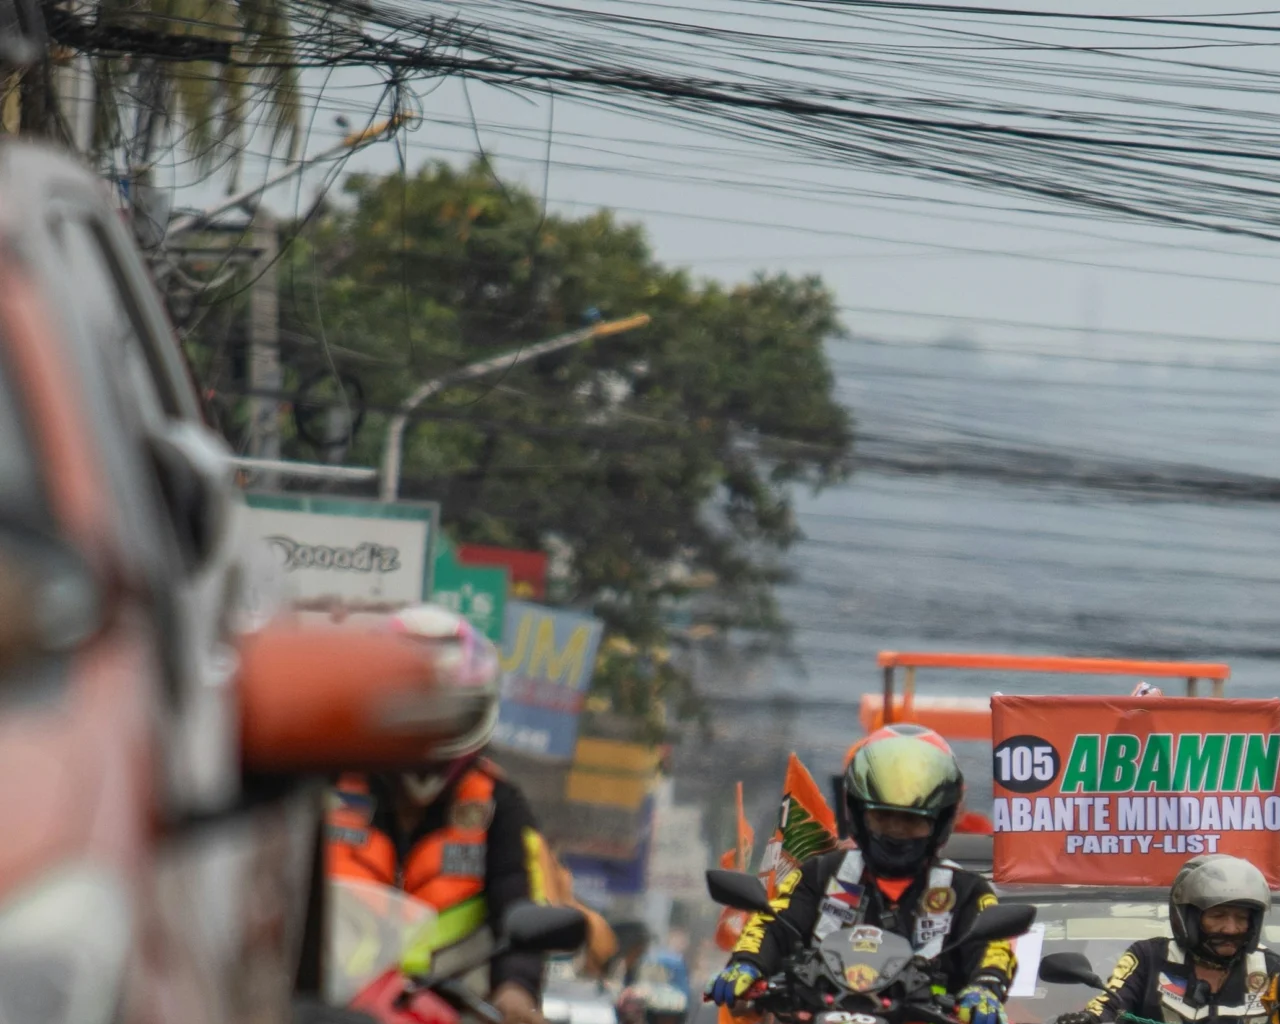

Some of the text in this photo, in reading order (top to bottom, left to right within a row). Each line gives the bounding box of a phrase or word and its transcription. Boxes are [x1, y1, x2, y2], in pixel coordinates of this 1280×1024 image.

[995, 745, 1054, 782] 105
[993, 796, 1110, 833] ABANTE
[1066, 834, 1221, 855] PARTY-LIST
